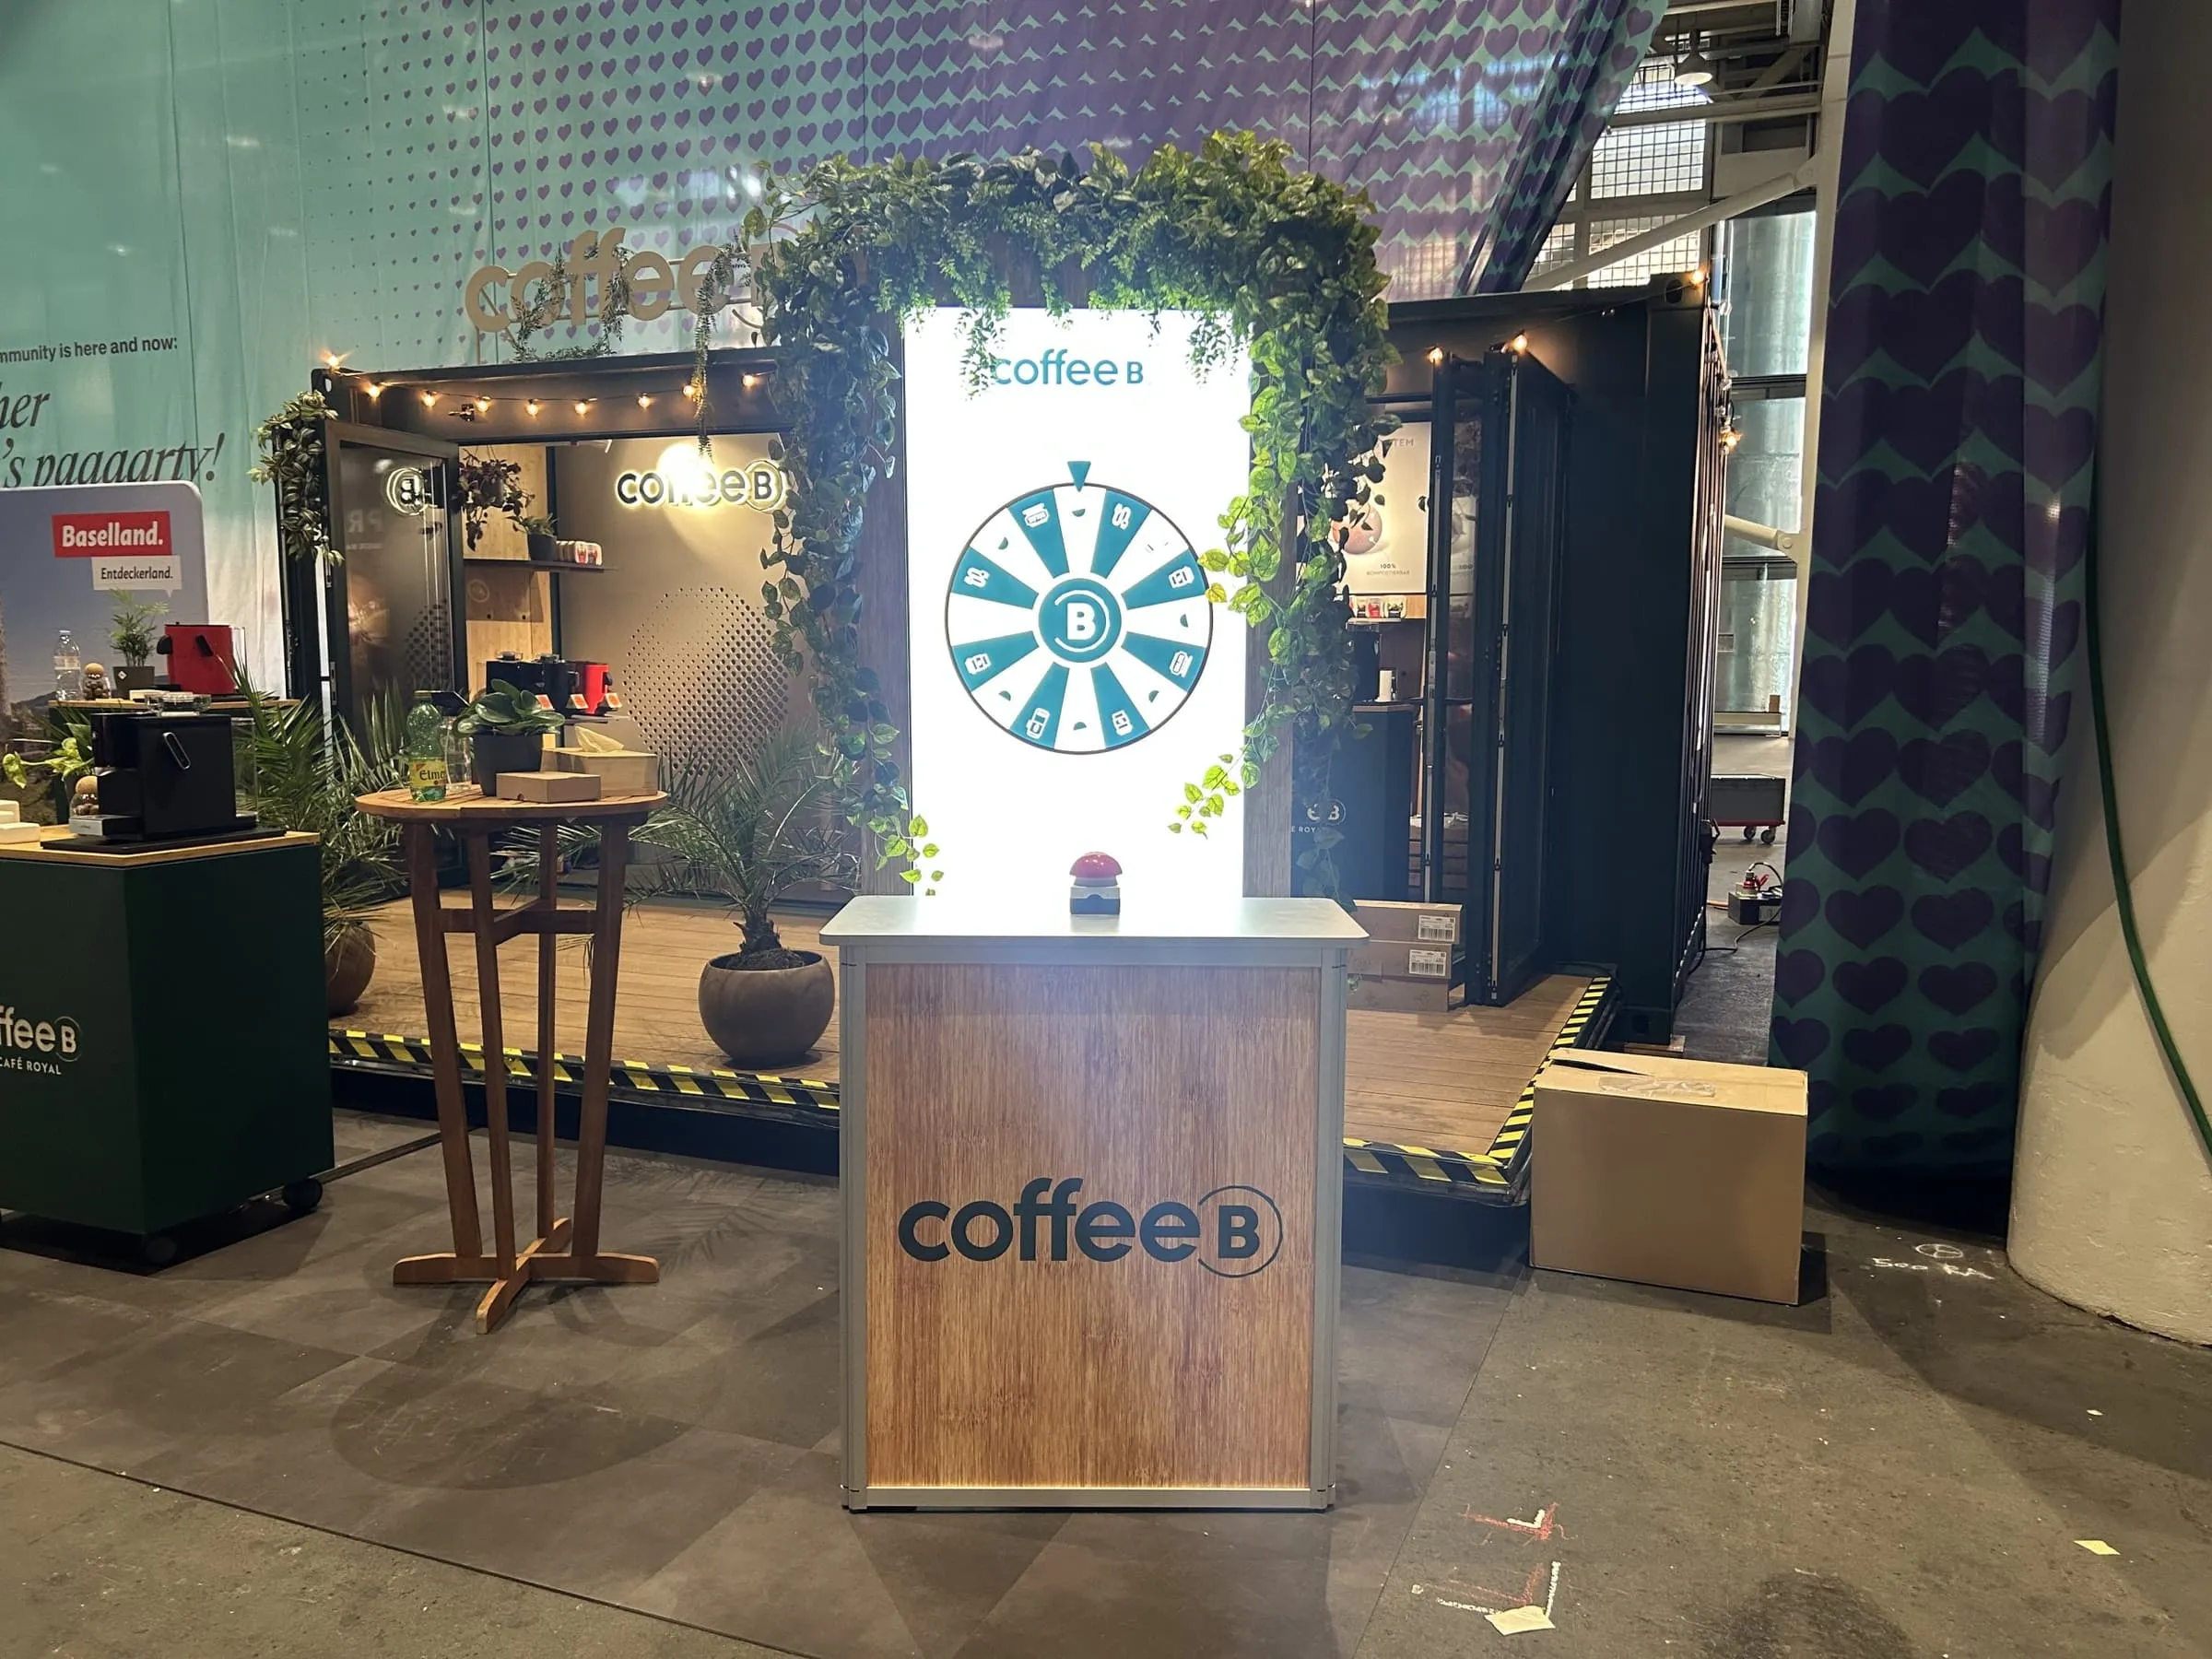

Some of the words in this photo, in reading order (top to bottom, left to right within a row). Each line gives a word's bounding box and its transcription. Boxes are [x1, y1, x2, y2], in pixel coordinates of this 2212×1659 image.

[59, 343, 72, 358] is
[75, 341, 107, 356] here
[111, 336, 137, 353] and
[142, 336, 178, 351] now:
[990, 348, 1118, 385] coffee
[1126, 360, 1144, 383] B
[33, 432, 225, 487] paaaarty!
[62, 521, 164, 547] Baselland.
[100, 566, 173, 580] Entdeckerland.
[1066, 602, 1097, 641] B
[26, 1060, 62, 1076] ROYAL
[898, 1177, 1200, 1263] coffee
